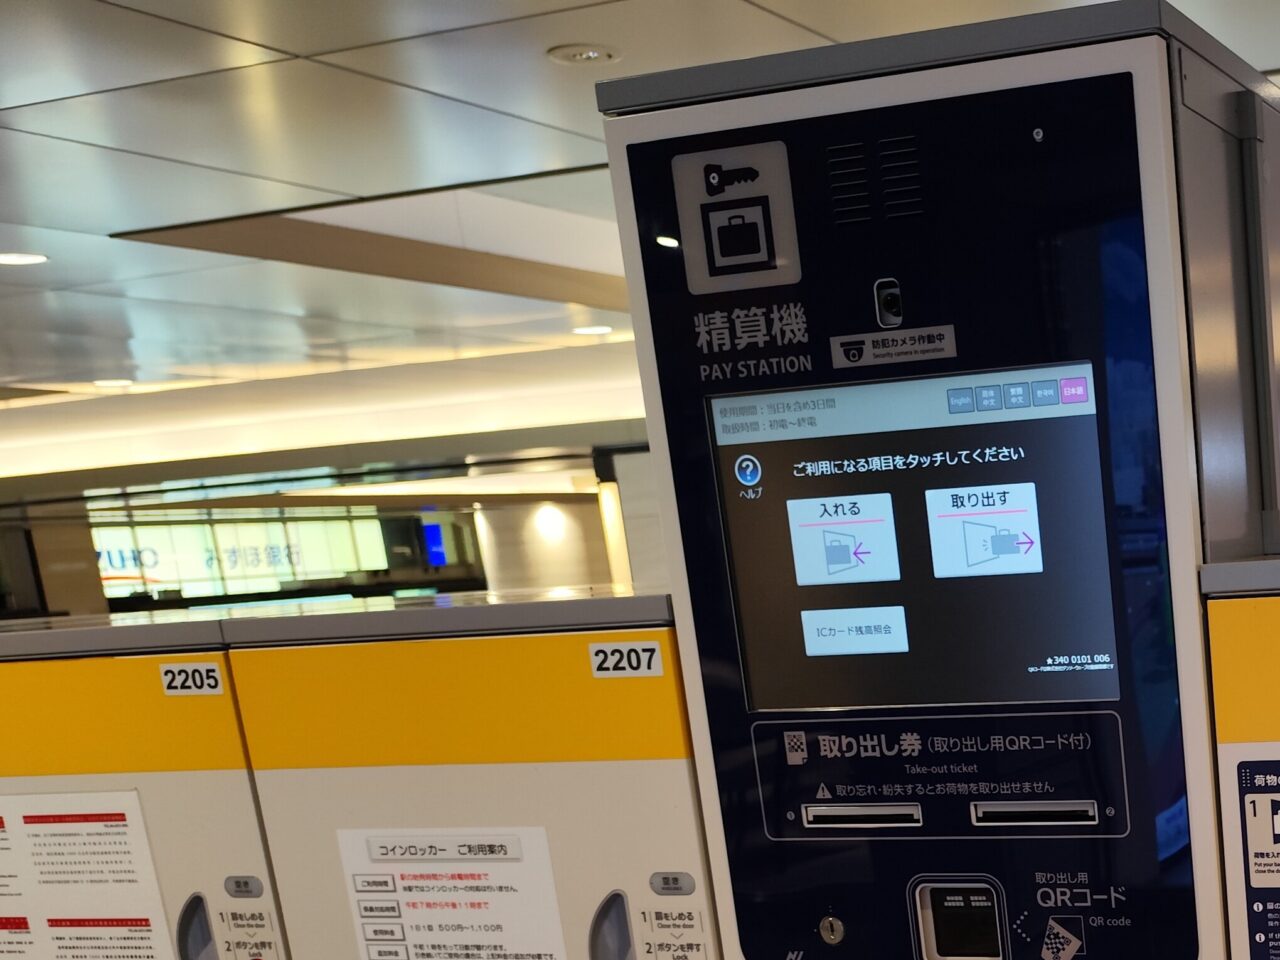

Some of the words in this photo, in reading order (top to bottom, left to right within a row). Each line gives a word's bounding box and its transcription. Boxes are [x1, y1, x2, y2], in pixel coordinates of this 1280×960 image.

[694, 302, 809, 354] 精算機
[872, 333, 946, 350] 防犯カメラ作動中
[700, 362, 733, 381] PAY
[737, 354, 813, 378] STATION
[792, 446, 1025, 477] ご利用になる項目をタッチしてください
[739, 487, 762, 499] ヘルプ
[951, 490, 1010, 509] 取り出す
[819, 502, 861, 518] 入れる
[816, 624, 892, 638] ICカード残高照会
[593, 648, 656, 672] 2207
[1071, 654, 1092, 664] 0101
[1094, 653, 1111, 663] 006
[163, 668, 219, 691] 2205
[819, 732, 922, 758] 取り出し券
[904, 763, 949, 774] Take-out
[950, 762, 978, 774] ticket
[1250, 800, 1257, 817] 1
[379, 845, 446, 856] コインロッカー
[457, 844, 508, 856] ご利用案内
[1035, 872, 1089, 884] 取り出し用
[1036, 886, 1126, 908] QRコード
[1089, 917, 1104, 927] QR
[1107, 916, 1132, 926] code
